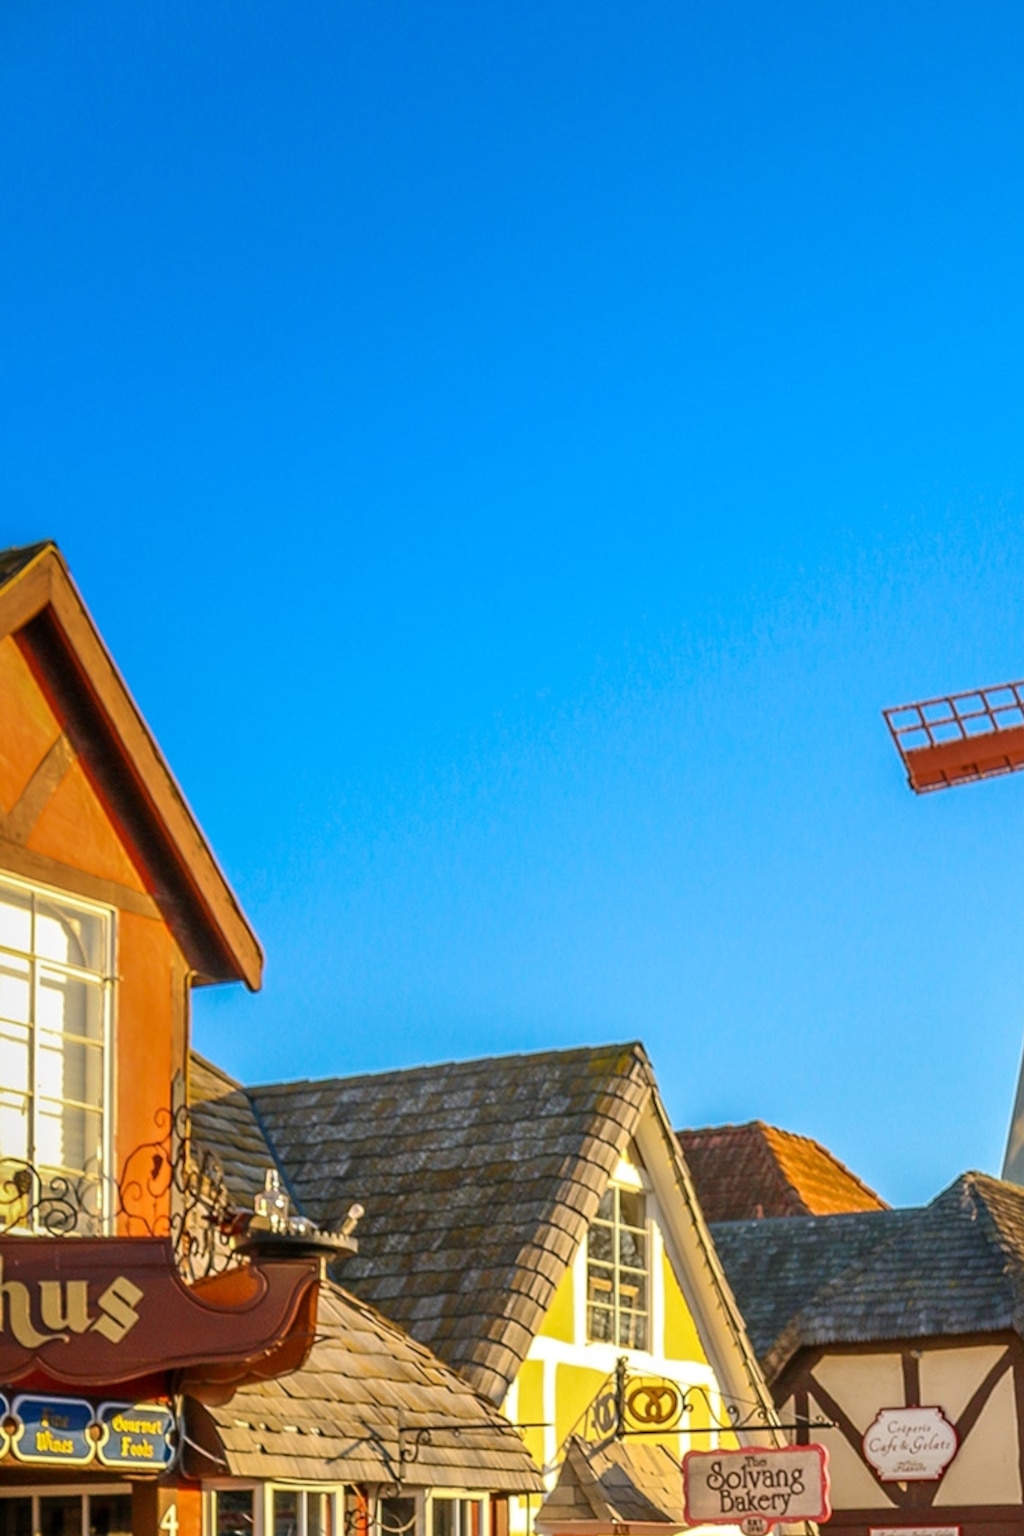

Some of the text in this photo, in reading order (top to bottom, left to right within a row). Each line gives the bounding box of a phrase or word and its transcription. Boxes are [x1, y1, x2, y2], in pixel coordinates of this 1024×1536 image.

[111, 1413, 163, 1435] Gourmet
[35, 1430, 75, 1455] Wines
[120, 1435, 154, 1459] Foods
[900, 1440, 908, 1450] &
[908, 1433, 952, 1455] Gelato
[744, 1456, 768, 1468] The
[706, 1461, 806, 1496] Solvang
[719, 1489, 793, 1516] Bakery
